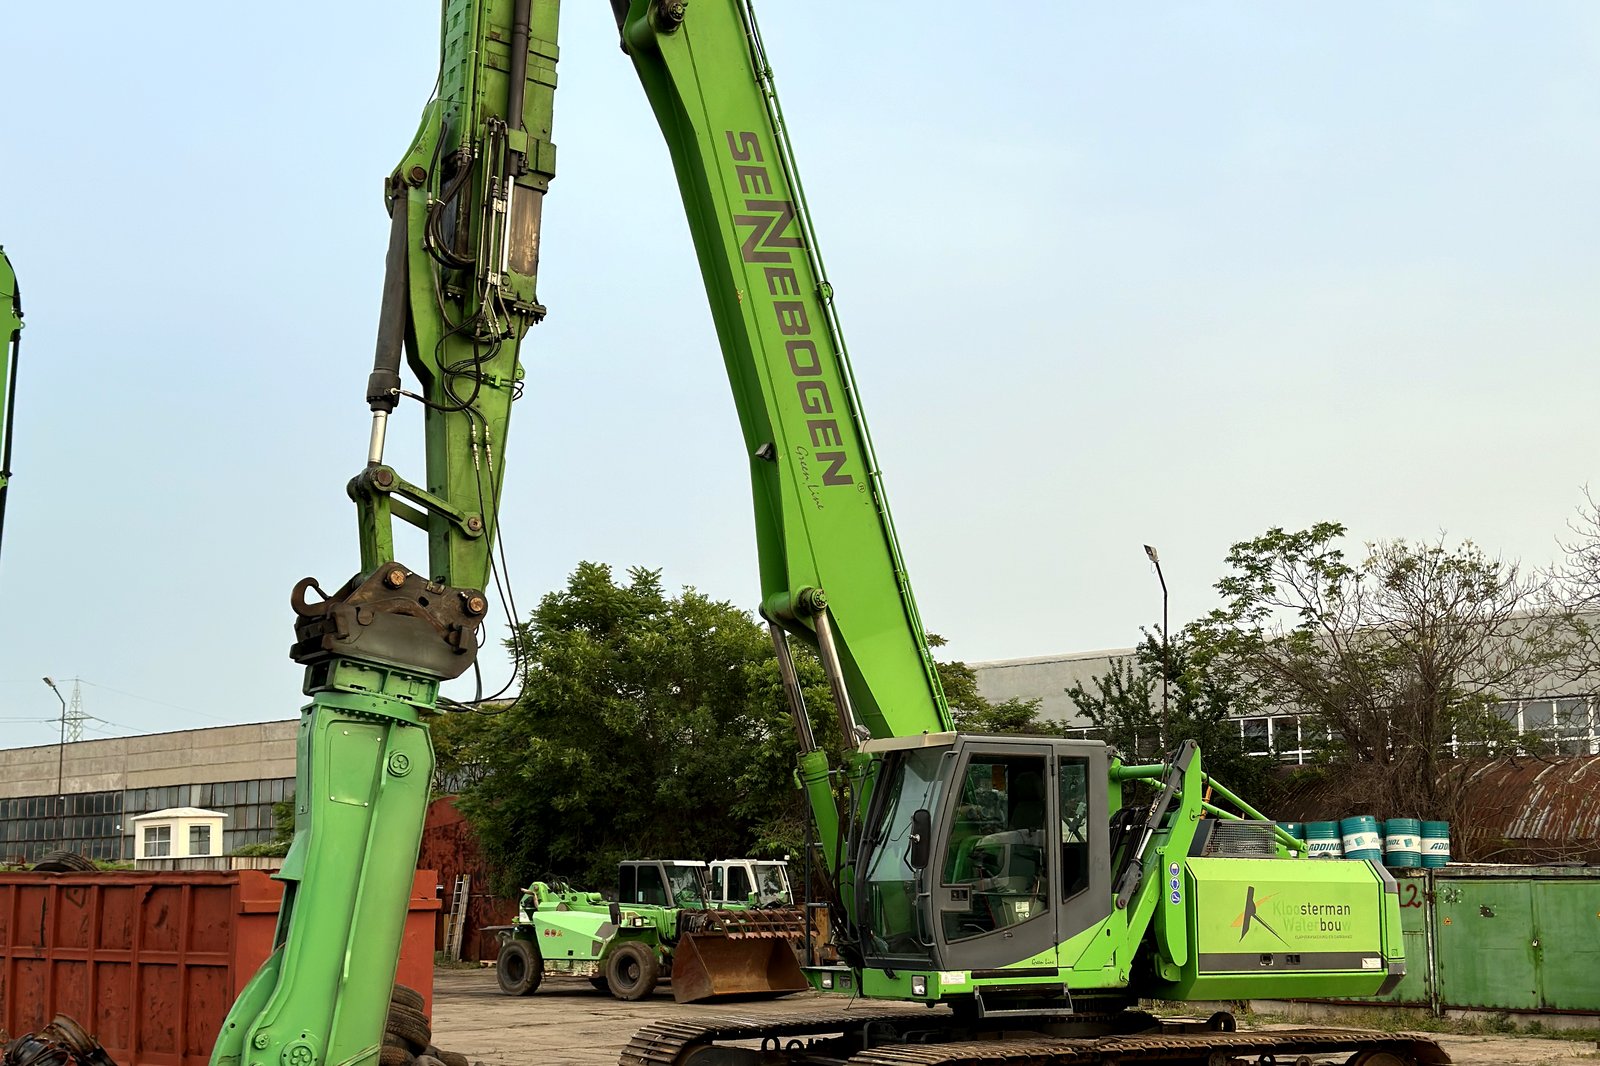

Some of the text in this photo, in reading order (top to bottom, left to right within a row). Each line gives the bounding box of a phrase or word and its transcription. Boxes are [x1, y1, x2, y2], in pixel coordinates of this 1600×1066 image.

[725, 130, 854, 487] SENNEBOGEN
[795, 445, 824, 510] Green Line
[1273, 902, 1351, 915] Kloosterman
